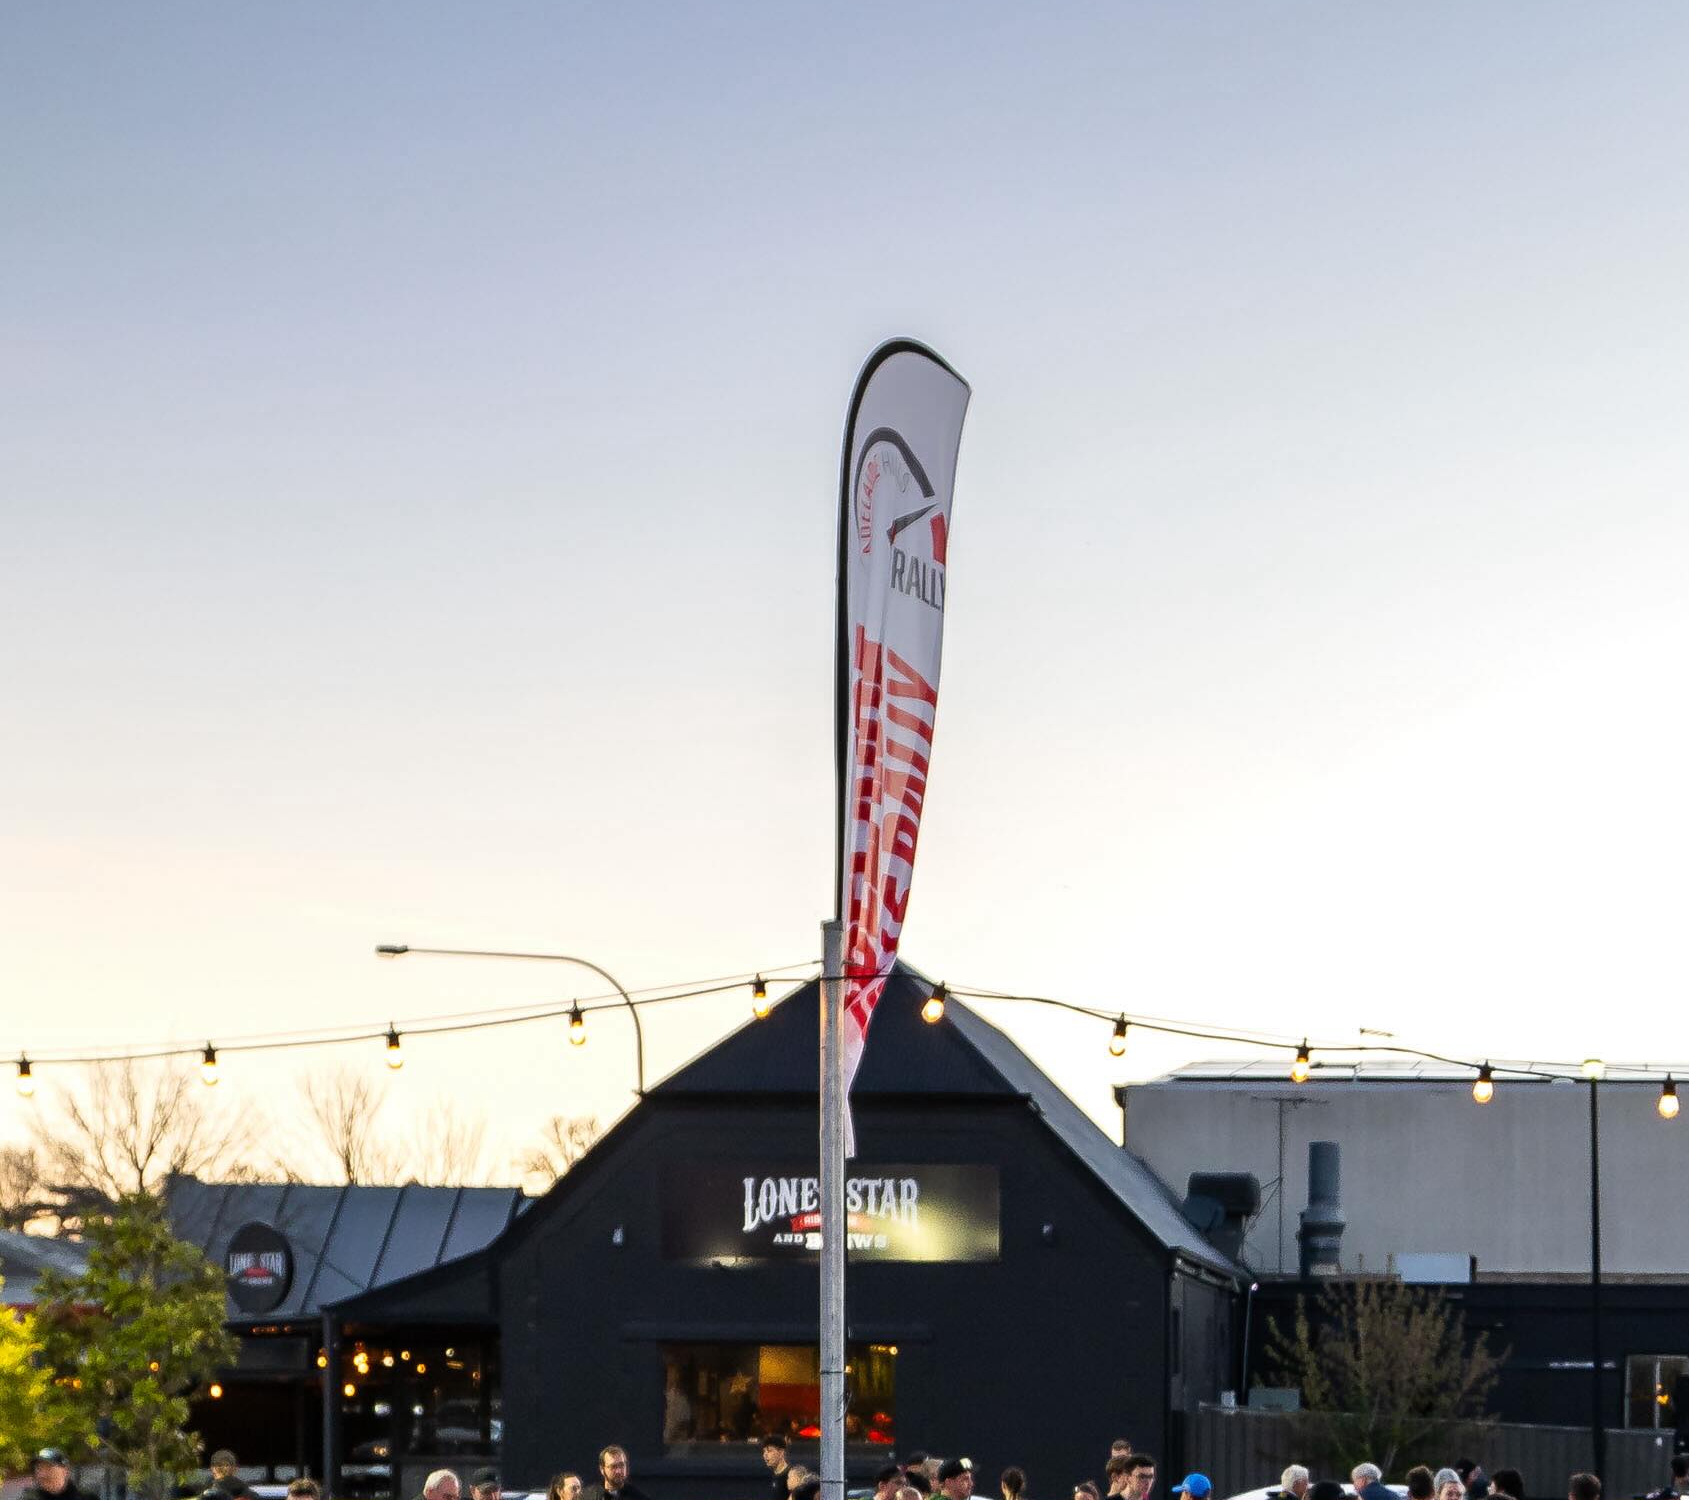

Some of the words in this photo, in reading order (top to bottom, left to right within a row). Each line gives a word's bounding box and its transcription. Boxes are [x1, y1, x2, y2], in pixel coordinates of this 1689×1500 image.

[743, 1177, 820, 1232] LONE
[846, 1177, 919, 1232] STAR
[773, 1233, 803, 1244] AND
